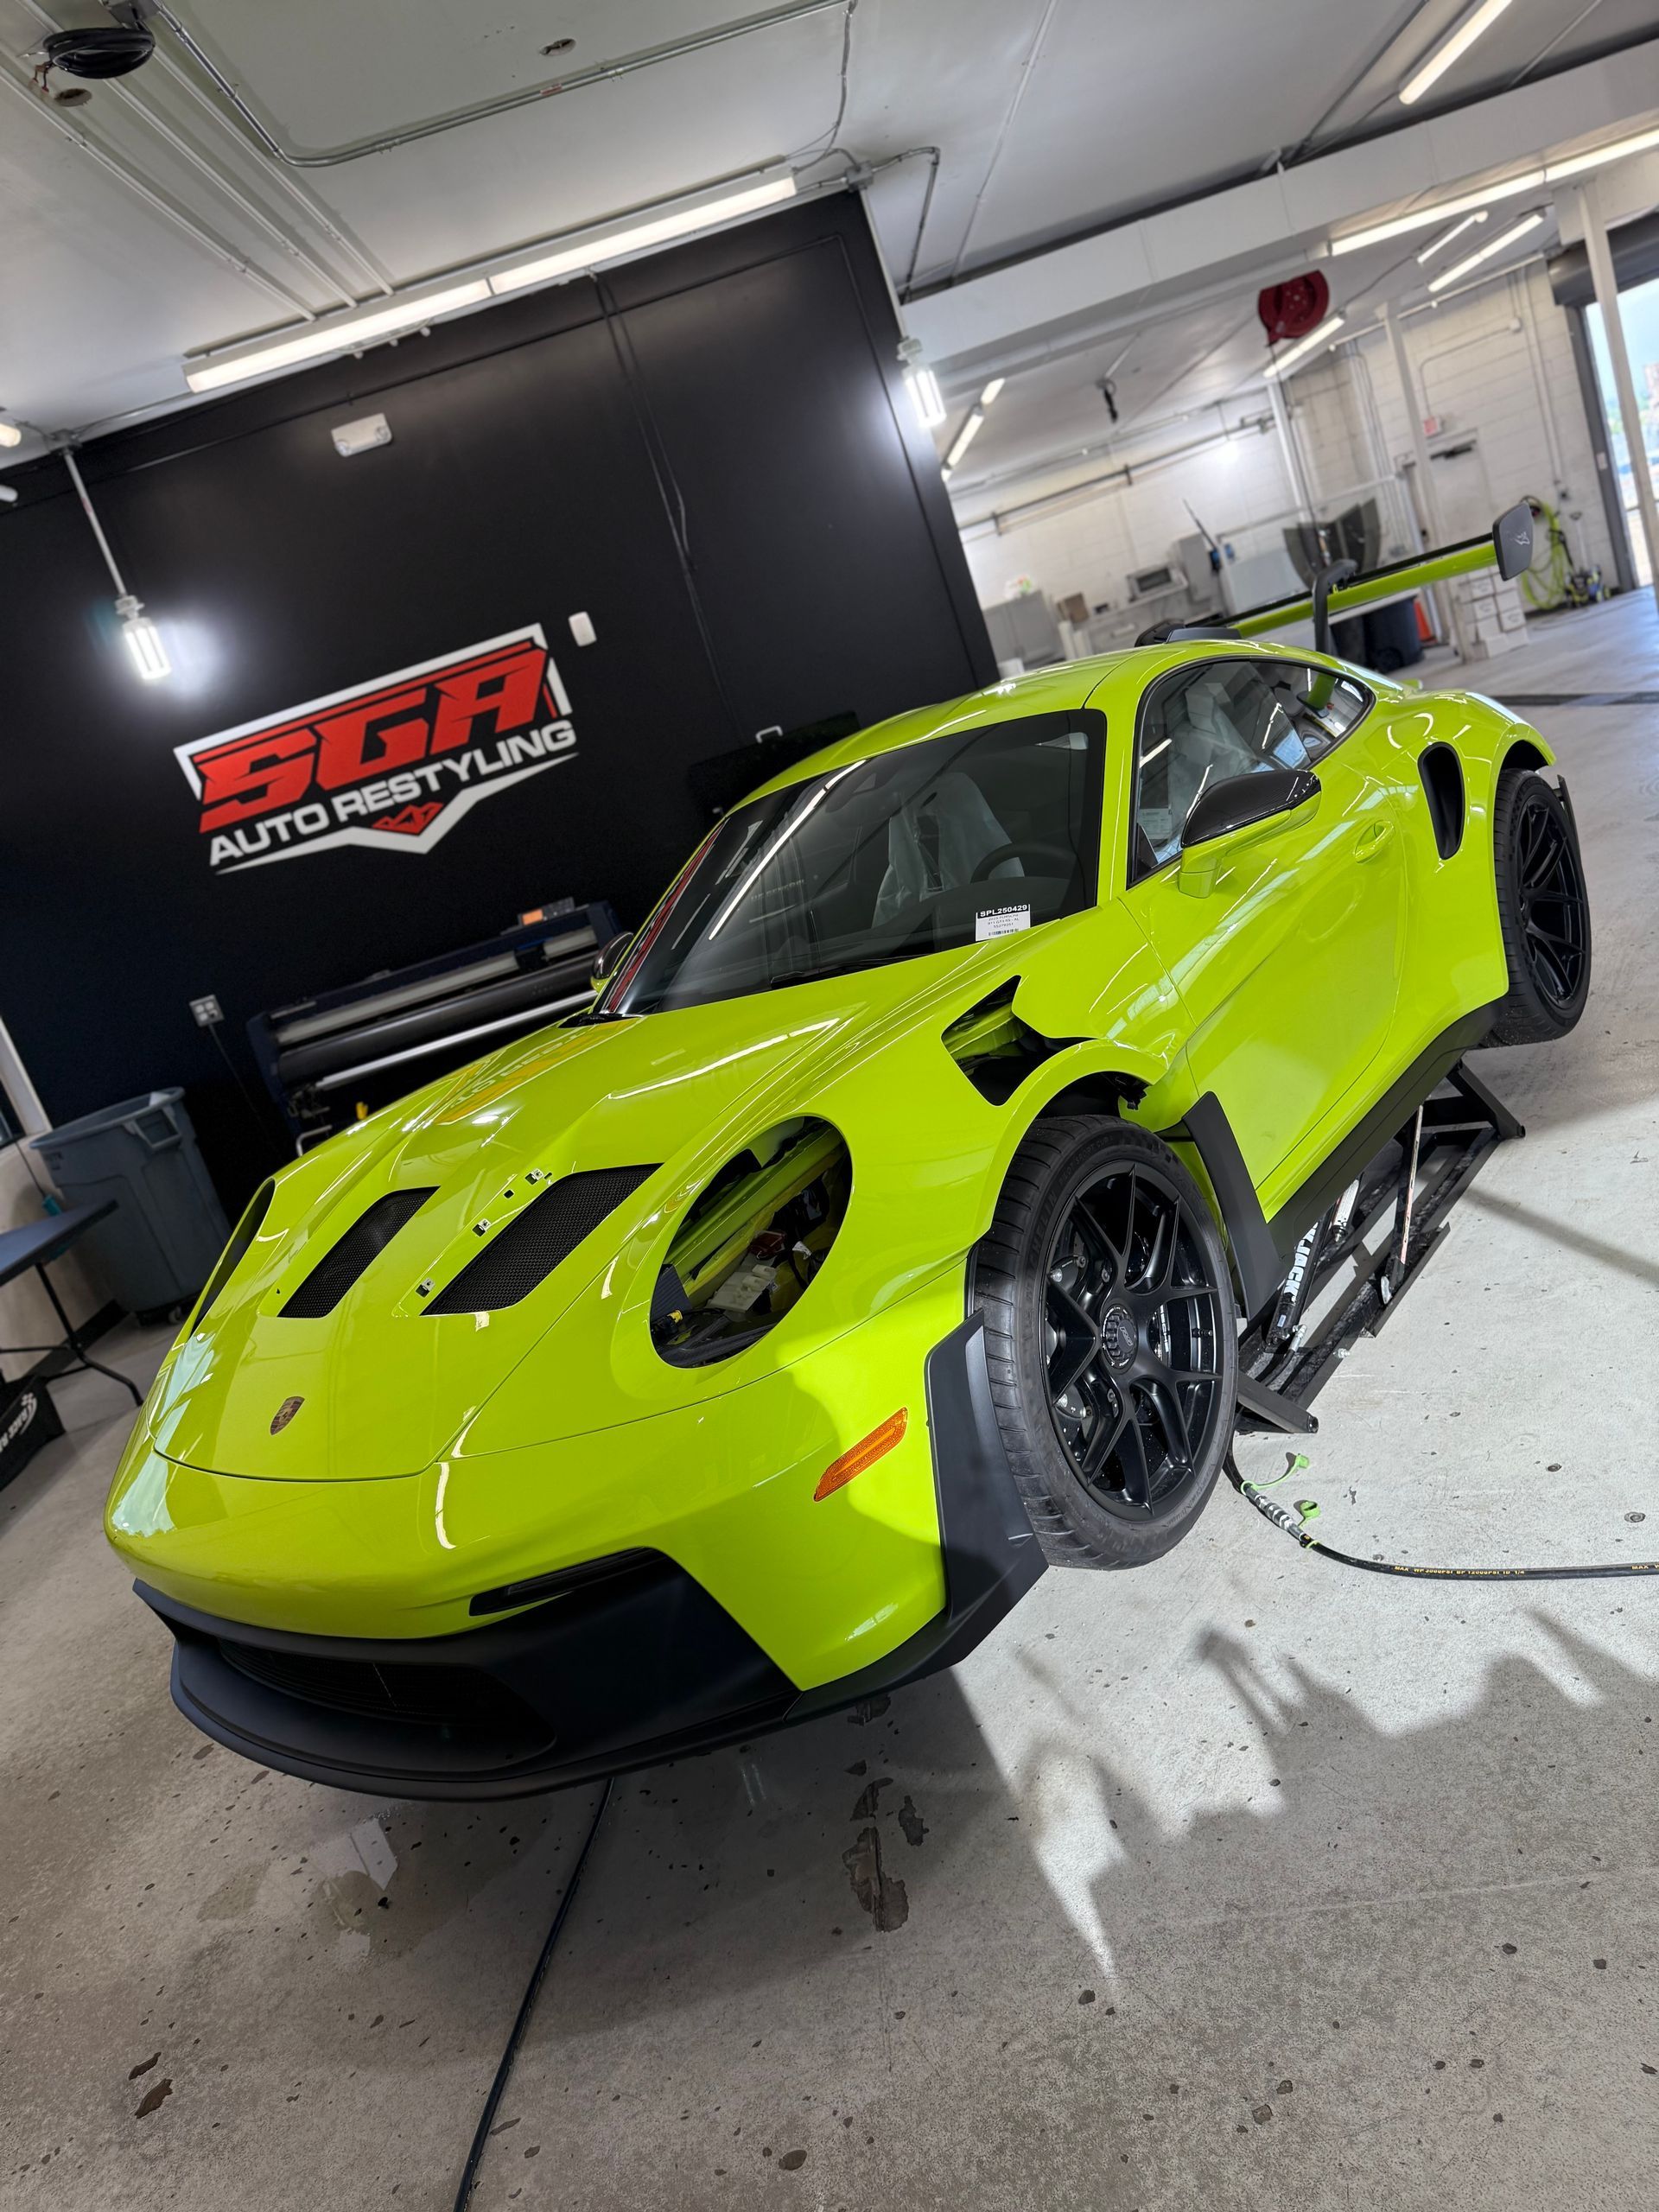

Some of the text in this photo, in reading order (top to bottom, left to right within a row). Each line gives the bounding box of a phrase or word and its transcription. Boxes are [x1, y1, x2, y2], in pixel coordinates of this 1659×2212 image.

[199, 650, 545, 832] SGA
[210, 721, 576, 867] AUTO RESTYLING
[980, 904, 1027, 917] SPL250429
[1283, 1222, 1319, 1297] KJACK
